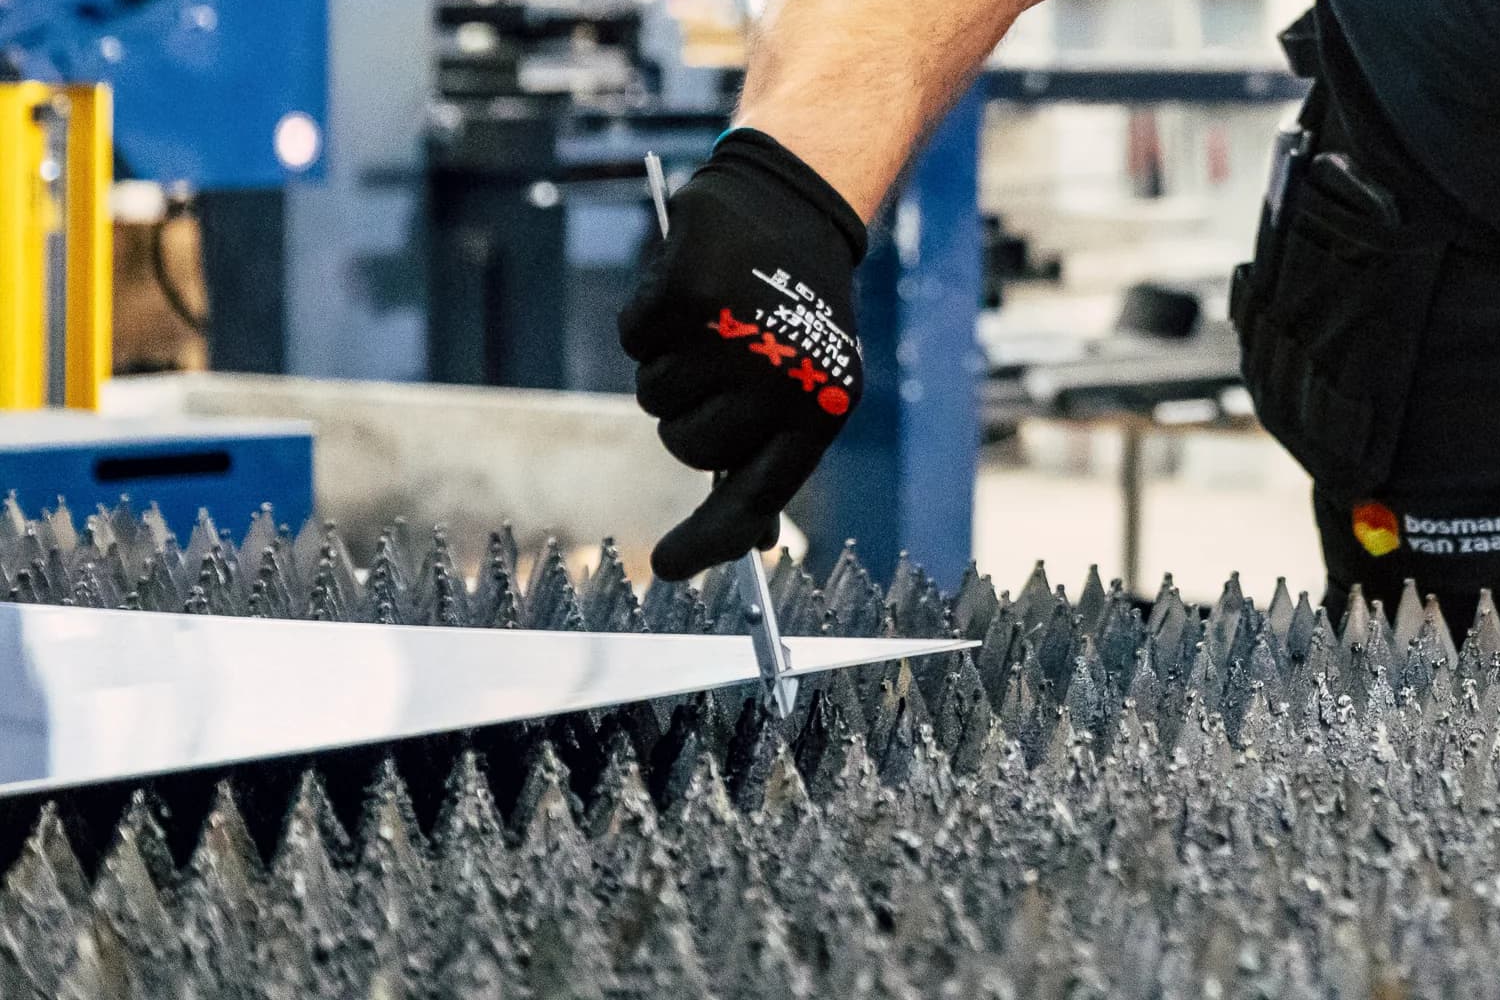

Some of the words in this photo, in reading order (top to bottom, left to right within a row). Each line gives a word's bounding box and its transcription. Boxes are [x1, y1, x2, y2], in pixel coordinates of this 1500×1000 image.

[754, 308, 854, 387] ESSENTIAL
[773, 304, 850, 368] PU-FLEX
[1406, 537, 1454, 555] van
